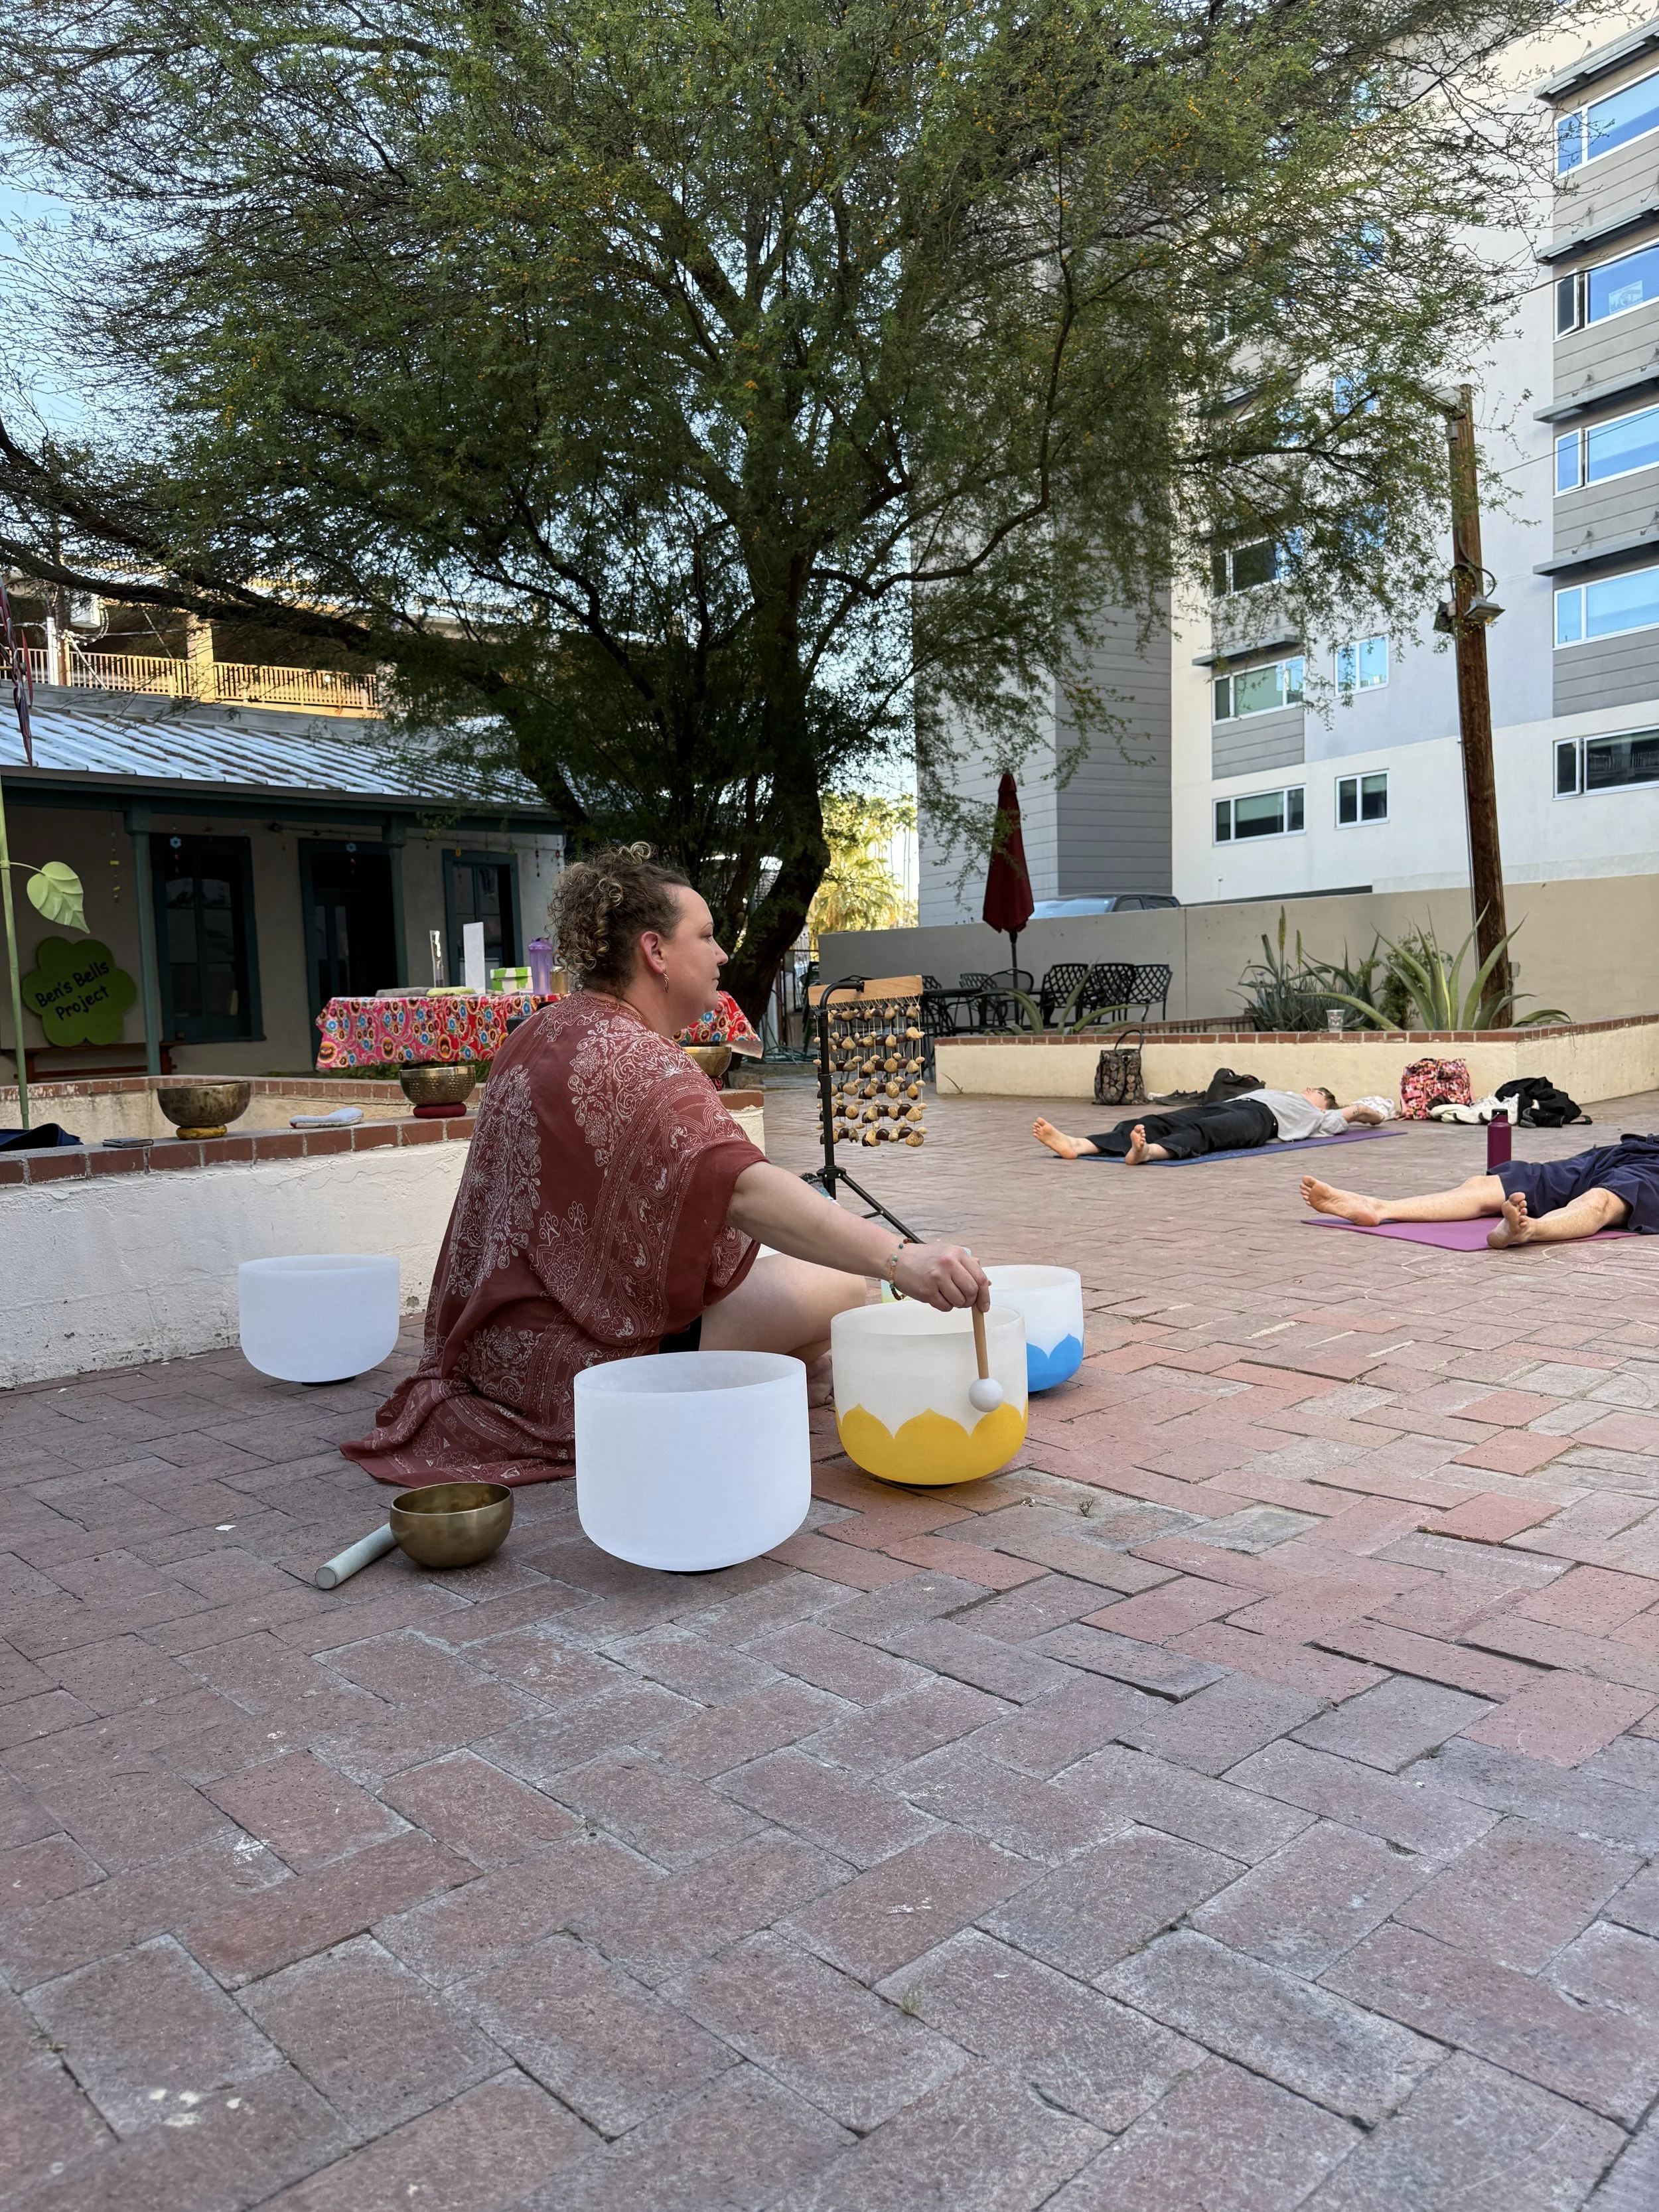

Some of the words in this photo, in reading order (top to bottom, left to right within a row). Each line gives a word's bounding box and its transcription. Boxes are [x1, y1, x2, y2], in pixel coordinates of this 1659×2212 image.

[35, 981, 73, 1007] Ben's
[72, 962, 109, 988] Bells
[55, 985, 109, 1021] Project
